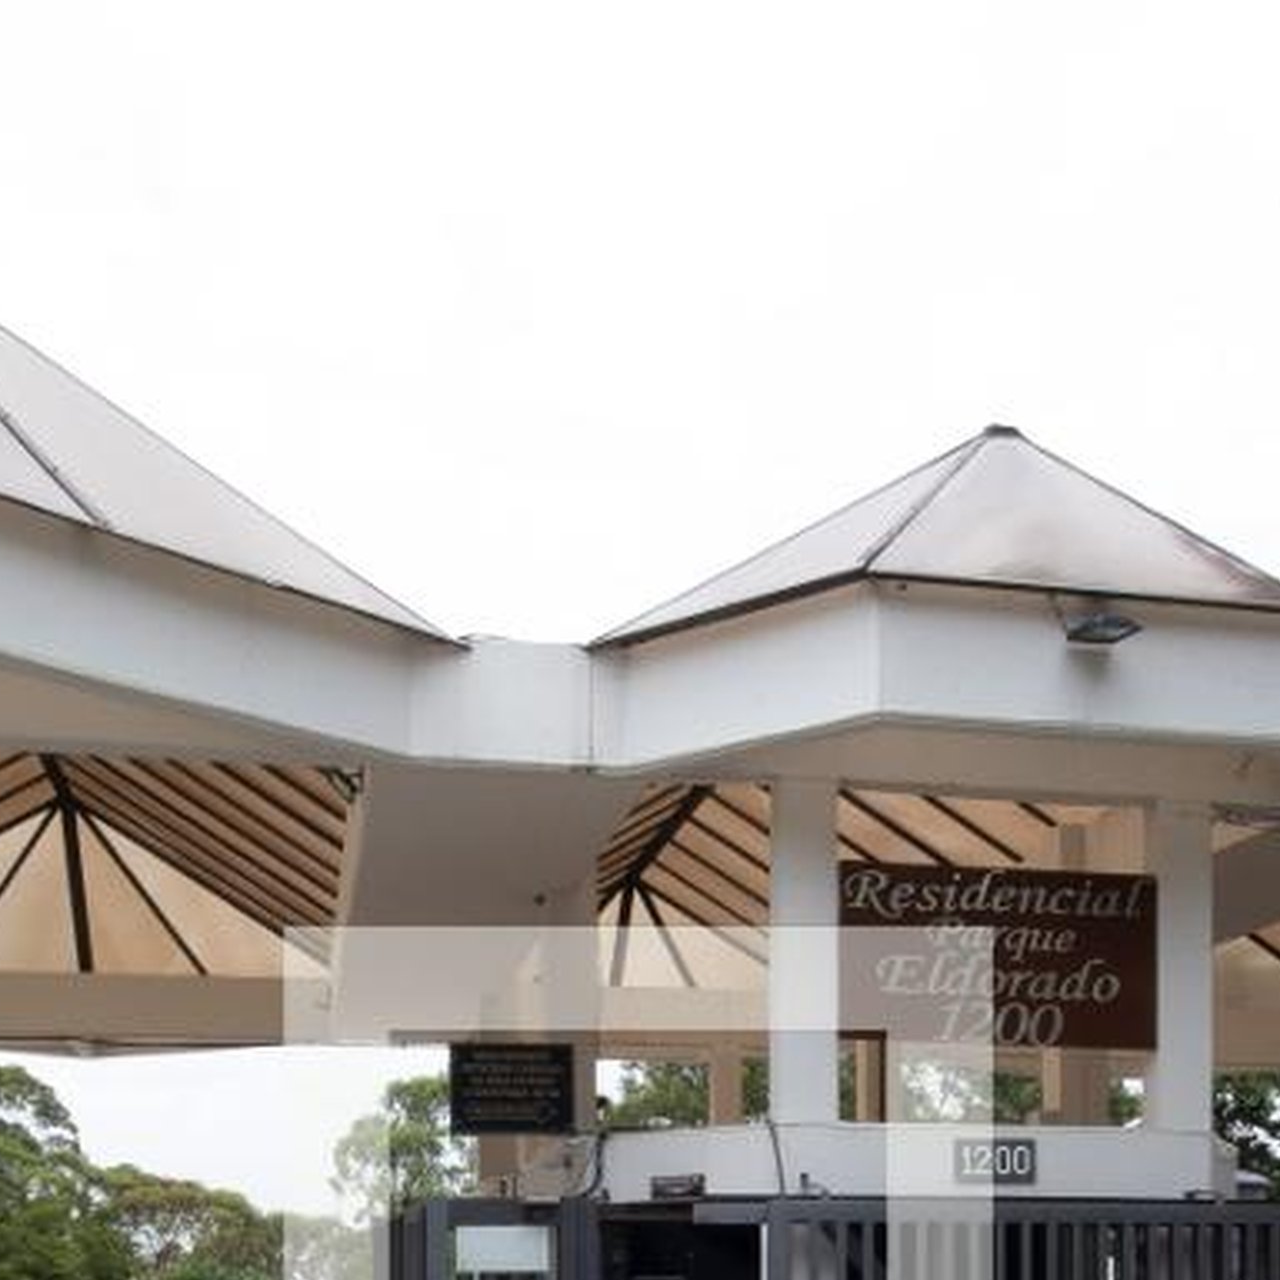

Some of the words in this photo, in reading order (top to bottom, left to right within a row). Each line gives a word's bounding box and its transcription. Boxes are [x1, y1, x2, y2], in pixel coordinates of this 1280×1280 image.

[844, 869, 1150, 918] Residencial
[924, 917, 1075, 959] Parque
[876, 956, 1122, 1003] Eldorado
[932, 1001, 1064, 1046] 1200
[961, 1145, 1031, 1175] 1200
